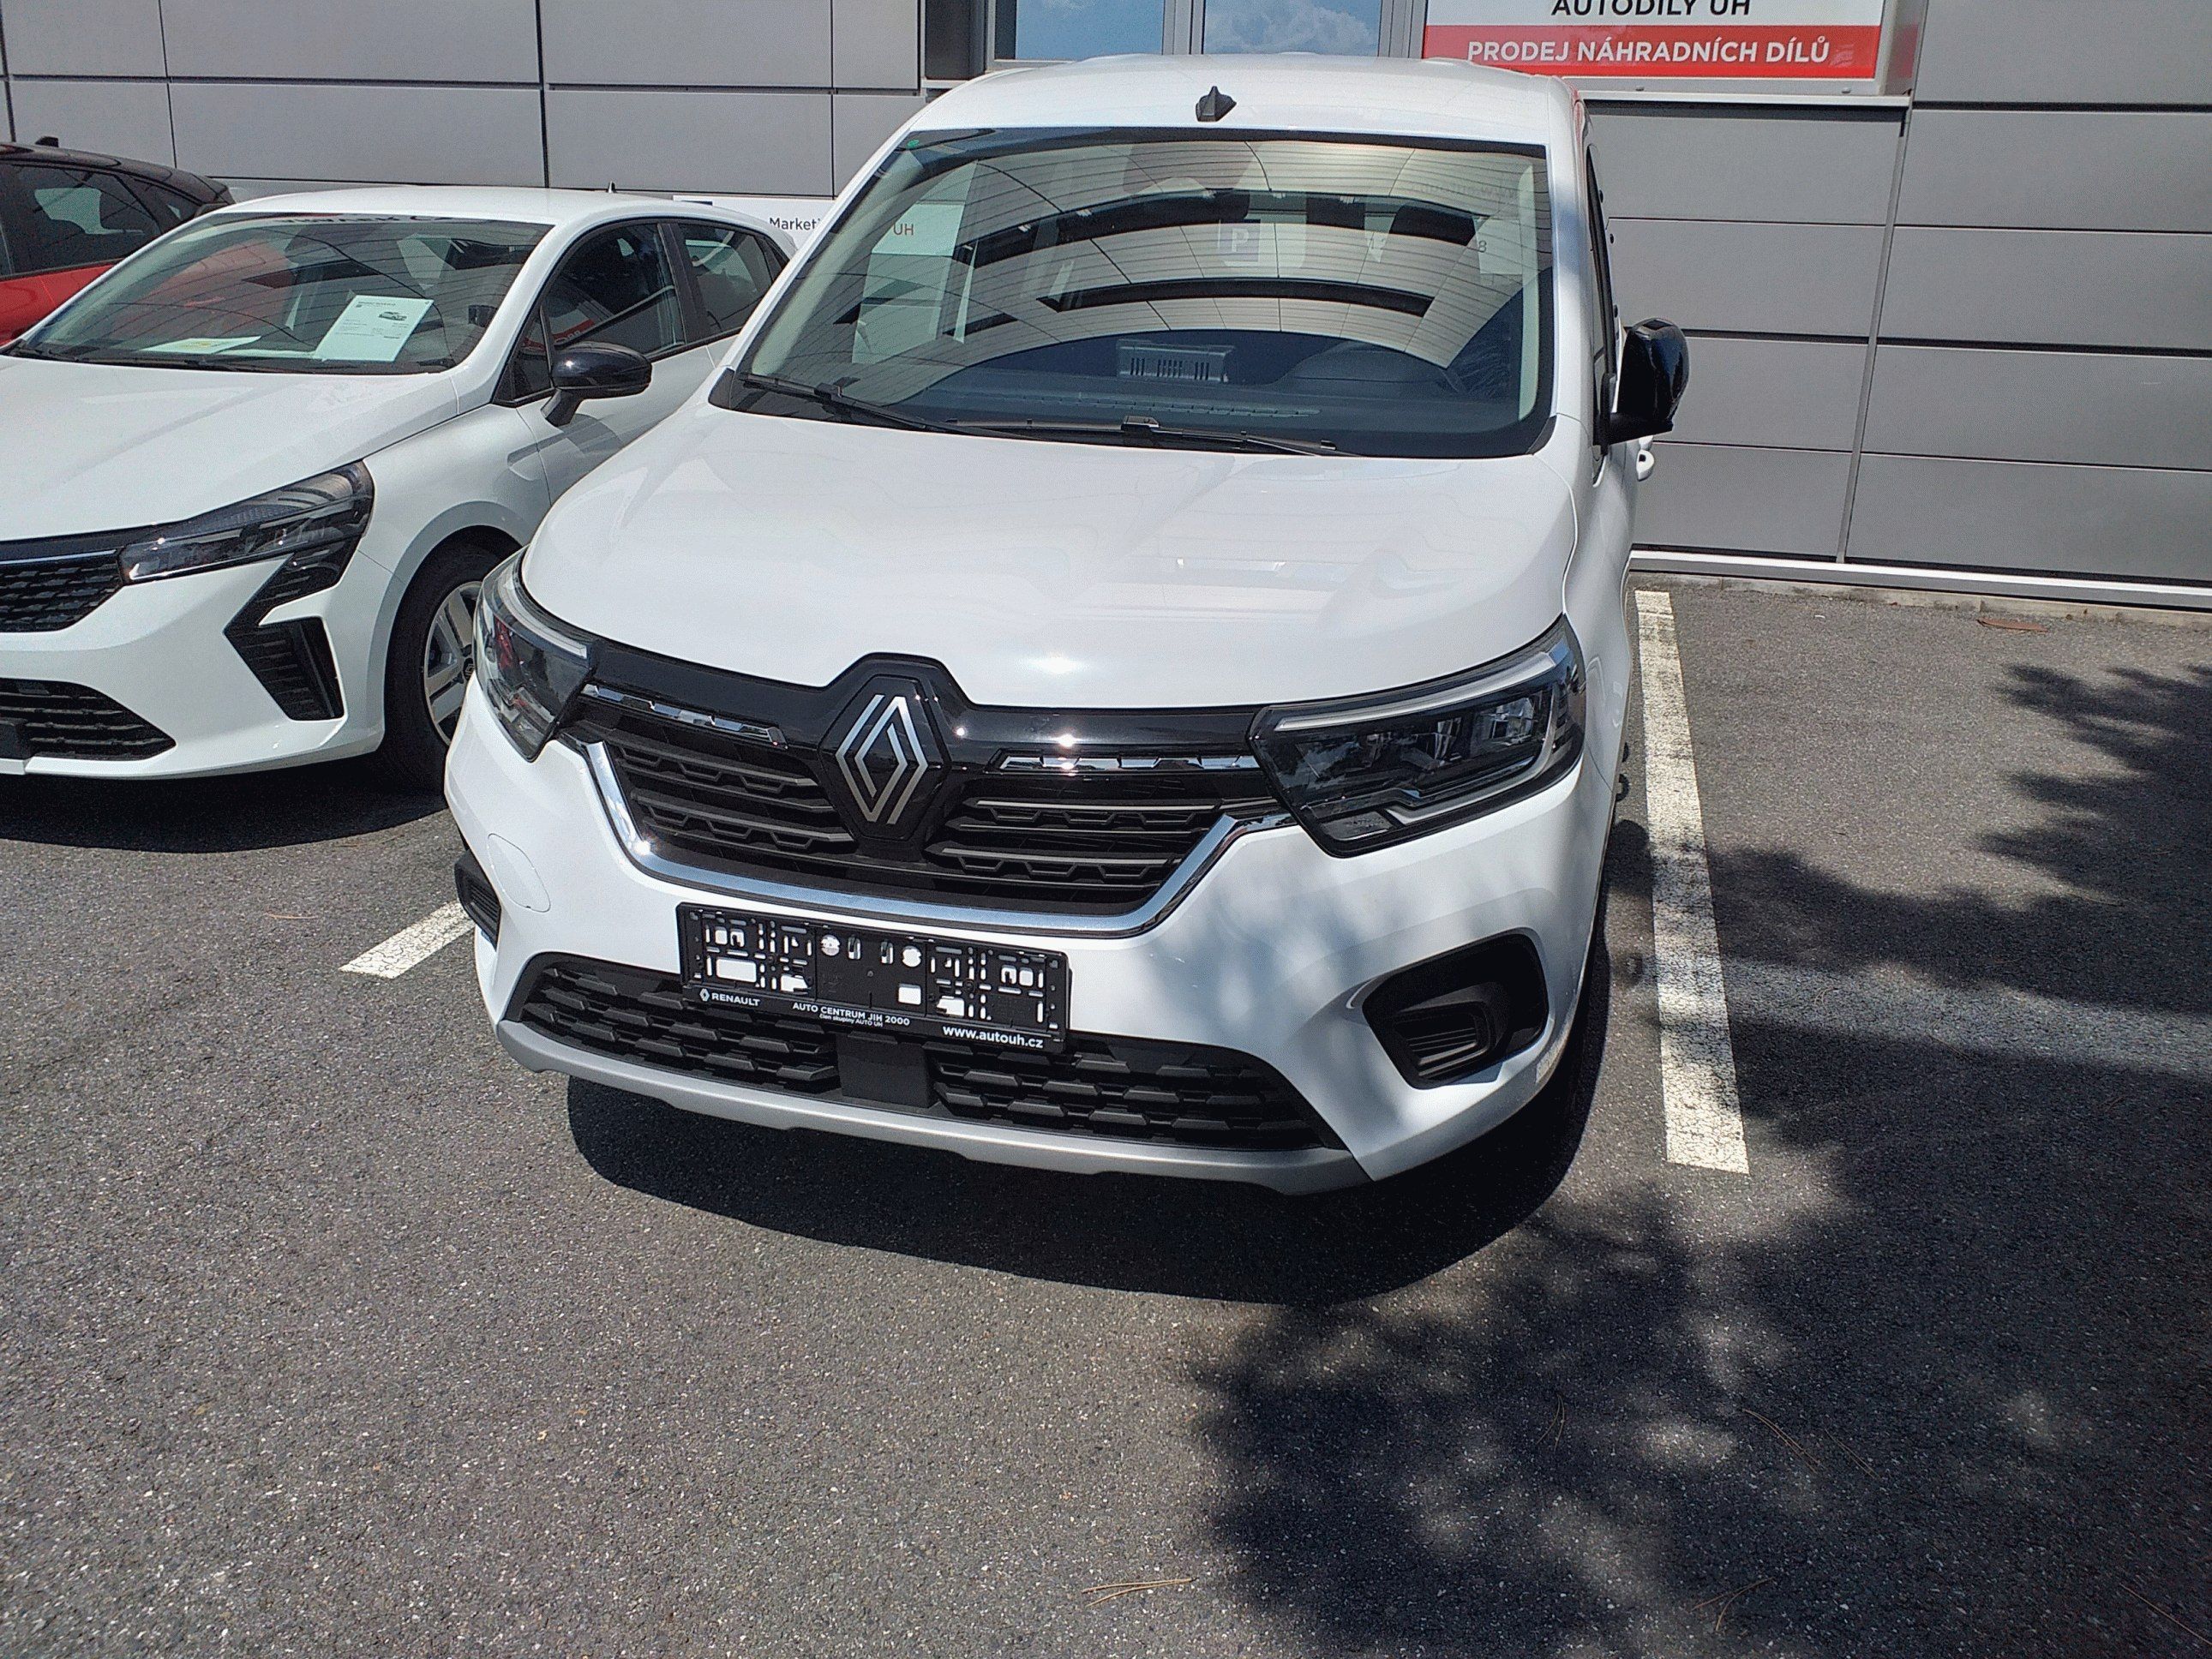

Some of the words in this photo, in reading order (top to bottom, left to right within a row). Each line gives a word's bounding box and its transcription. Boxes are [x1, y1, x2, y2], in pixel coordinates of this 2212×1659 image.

[1710, 0, 1750, 15] UH
[1467, 41, 1569, 62] PRODEJ
[1577, 36, 1757, 63] NÁHRADNÍCH
[1765, 35, 1830, 63] DÍLŮ
[769, 217, 821, 231] Market
[893, 223, 914, 236] UH
[711, 992, 760, 1007] RENAULT
[793, 1002, 818, 1012] AUTO
[820, 1006, 866, 1020] CENTRUM
[867, 1013, 883, 1021] JIH
[884, 1015, 910, 1027] 2000
[942, 1026, 1044, 1049] www.autouh.cz
